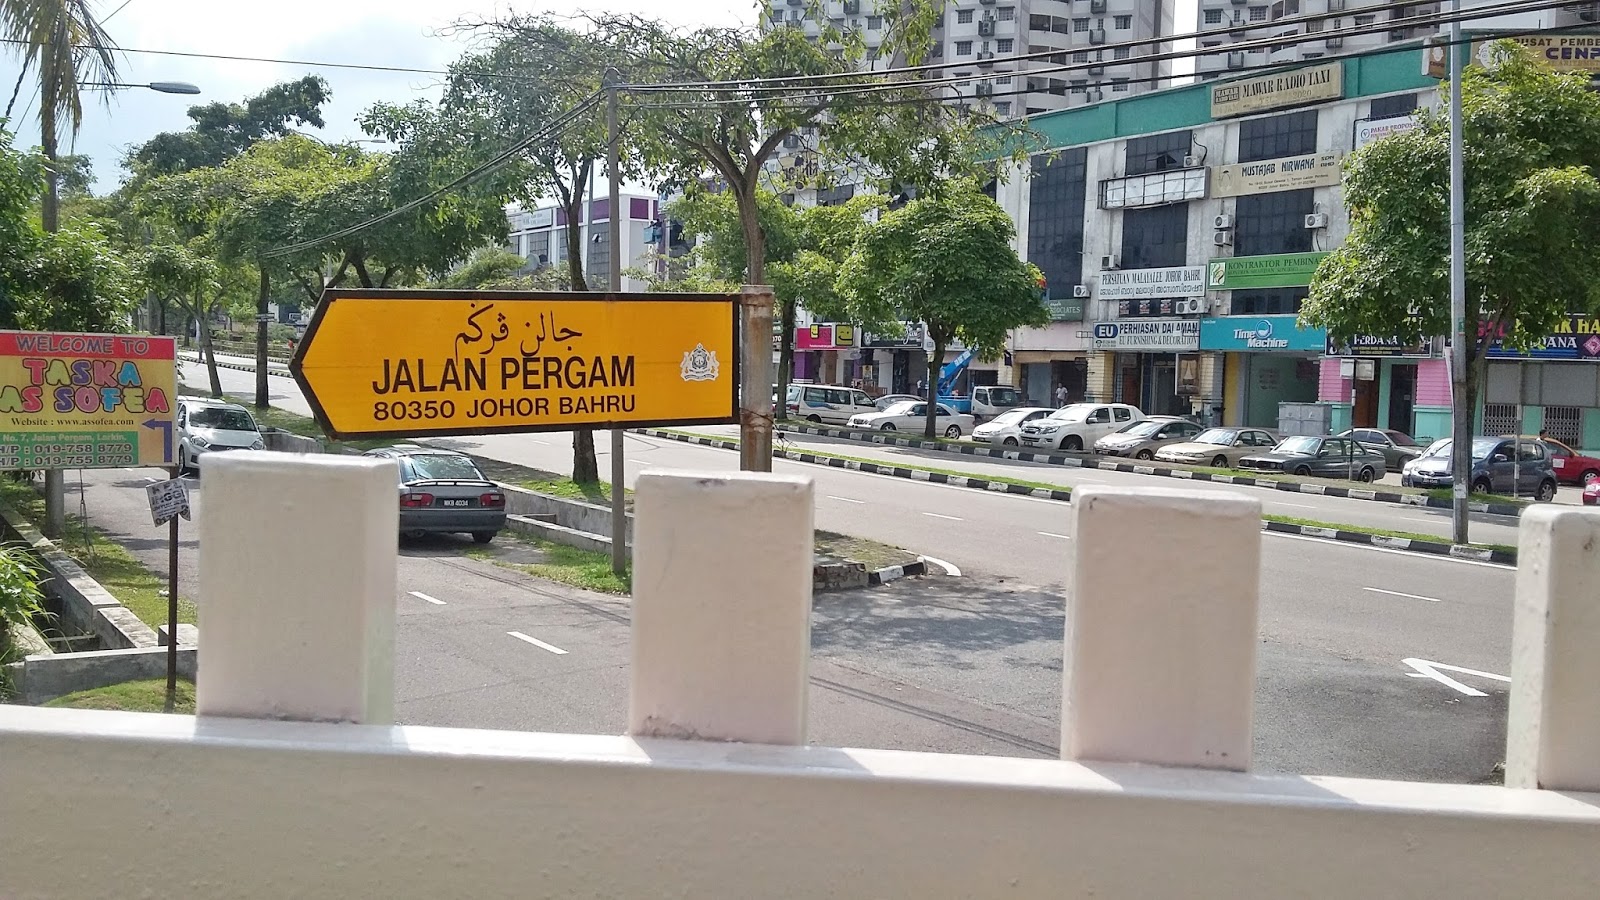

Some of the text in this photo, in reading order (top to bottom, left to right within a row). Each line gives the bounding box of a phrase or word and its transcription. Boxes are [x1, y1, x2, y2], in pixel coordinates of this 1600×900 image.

[1242, 69, 1331, 98] MAWAR RADIO TAXI
[1241, 158, 1315, 178] MUSTAJAB NIRWANA
[1228, 257, 1322, 270] KONTRAKTOR PEMBINA
[1102, 273, 1130, 285] PERSATUAN
[1166, 270, 1182, 283] JOHOR
[1184, 270, 1201, 282] BAHRU
[1099, 326, 1114, 338] EU
[1120, 323, 1160, 334] PERHIASAN
[1234, 328, 1256, 339] Time
[16, 335, 149, 355] WELCOME TO
[1246, 338, 1288, 348] Machine
[22, 358, 142, 386] TASKA
[372, 355, 636, 394] JALAN PERGAM
[0, 385, 170, 414] AS SOFEA
[374, 394, 636, 421] 80350 JOHOR BAHRU
[11, 417, 48, 426] Website
[57, 418, 134, 426] www.assofea.com
[2, 434, 127, 442] No. 7, Jalan Pergam, Larkin.
[0, 444, 20, 454] H/P
[34, 444, 93, 454] 019-758
[98, 443, 133, 454] 8779
[0, 456, 20, 466] H/P
[34, 456, 93, 466] 019-755
[98, 454, 133, 464] 8779
